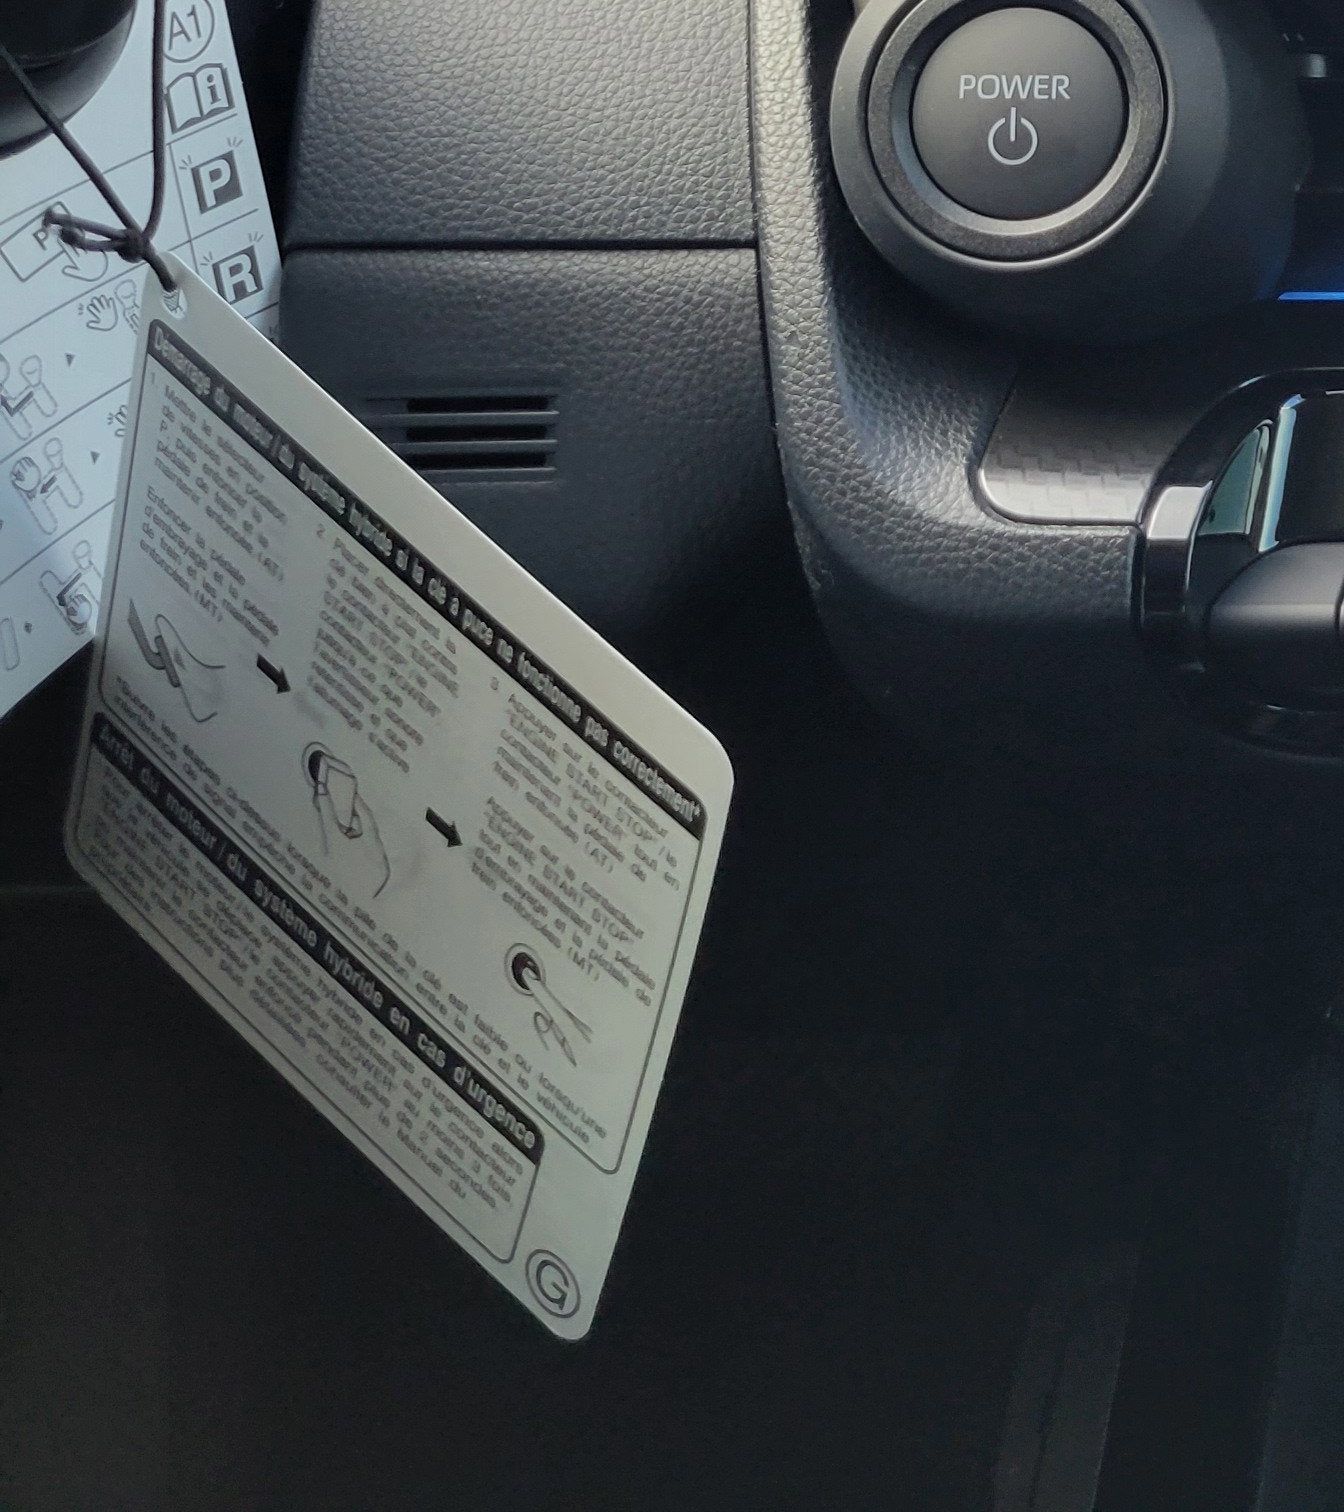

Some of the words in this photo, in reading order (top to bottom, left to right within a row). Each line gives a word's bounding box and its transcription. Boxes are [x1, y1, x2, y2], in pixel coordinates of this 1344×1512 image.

[167, 3, 203, 51] A1
[958, 74, 1071, 100] POWER
[199, 156, 232, 208] P
[217, 250, 259, 305] R
[252, 872, 319, 954] système
[321, 936, 385, 1017] hybride
[388, 1002, 412, 1039] en
[416, 1028, 448, 1072] cas
[450, 1057, 537, 1158] d'urgence
[536, 1259, 569, 1311] G
